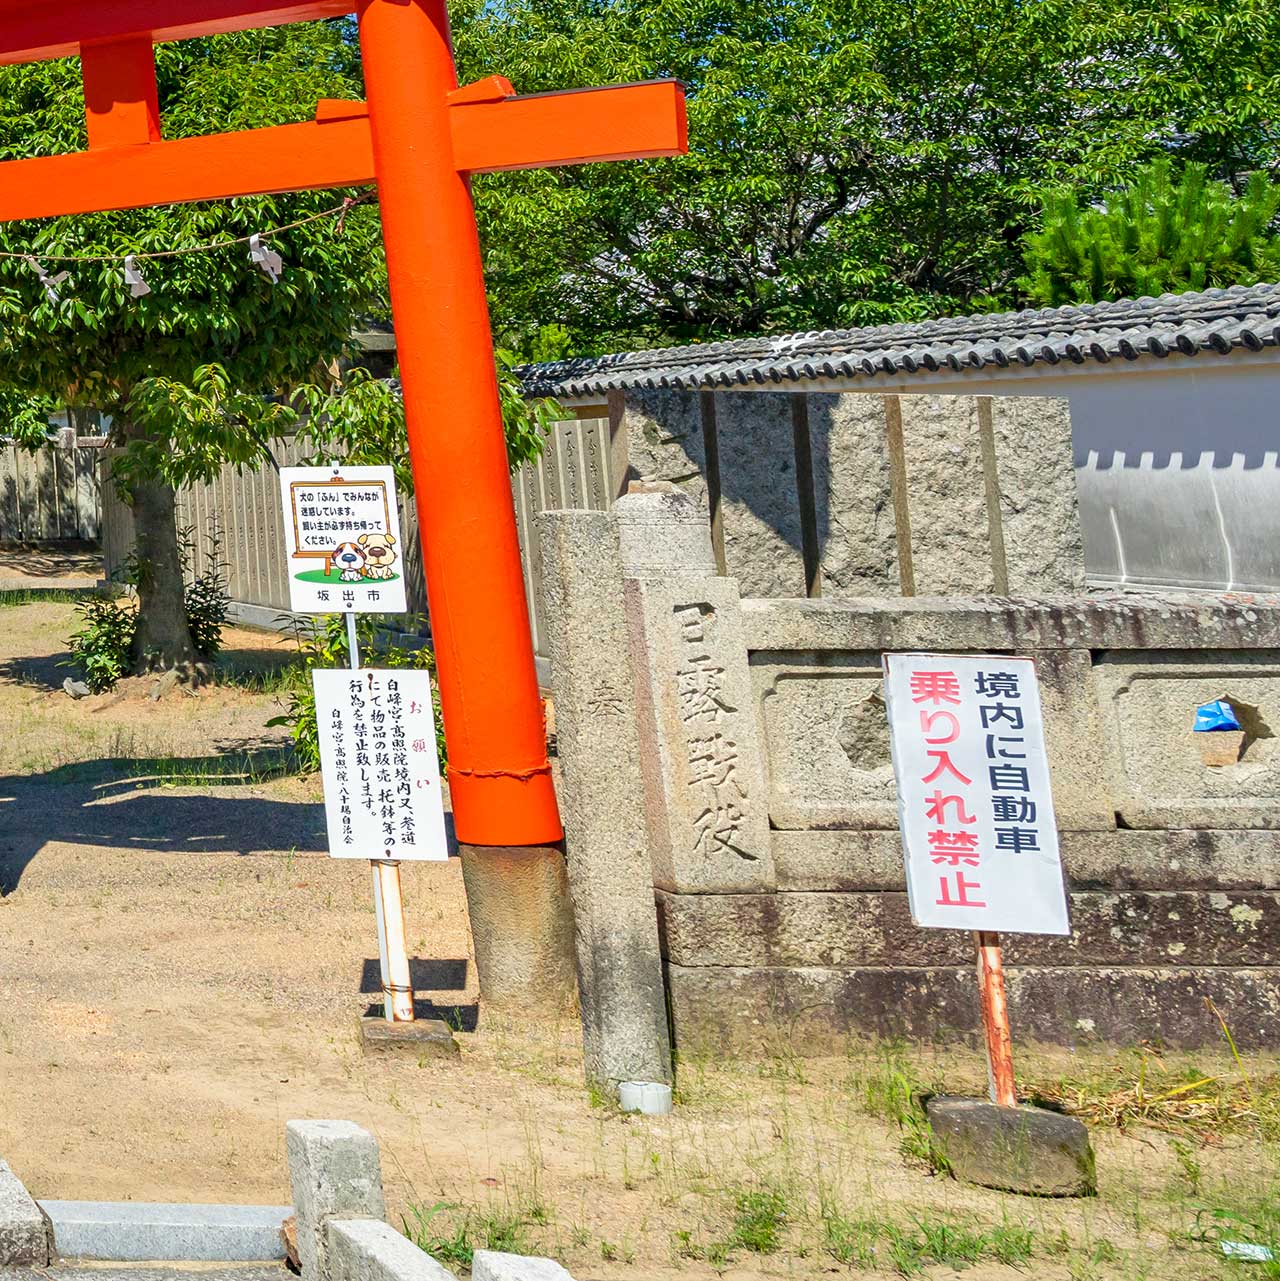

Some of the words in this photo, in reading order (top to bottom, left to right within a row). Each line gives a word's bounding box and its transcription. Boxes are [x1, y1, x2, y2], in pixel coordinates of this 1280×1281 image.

[299, 492, 379, 502] 犬の「ふん」でみんなが
[301, 506, 356, 517] 迷惑しています。
[302, 521, 382, 531] 飼い主が必ず持ち帰って
[305, 536, 337, 545] ください。
[318, 590, 380, 601] 坂出市
[349, 680, 377, 816] 行為を禁止致します。
[410, 701, 430, 789] お願い
[974, 670, 1041, 855] 境内に自動車
[909, 670, 987, 908] 乗り入れ禁止
